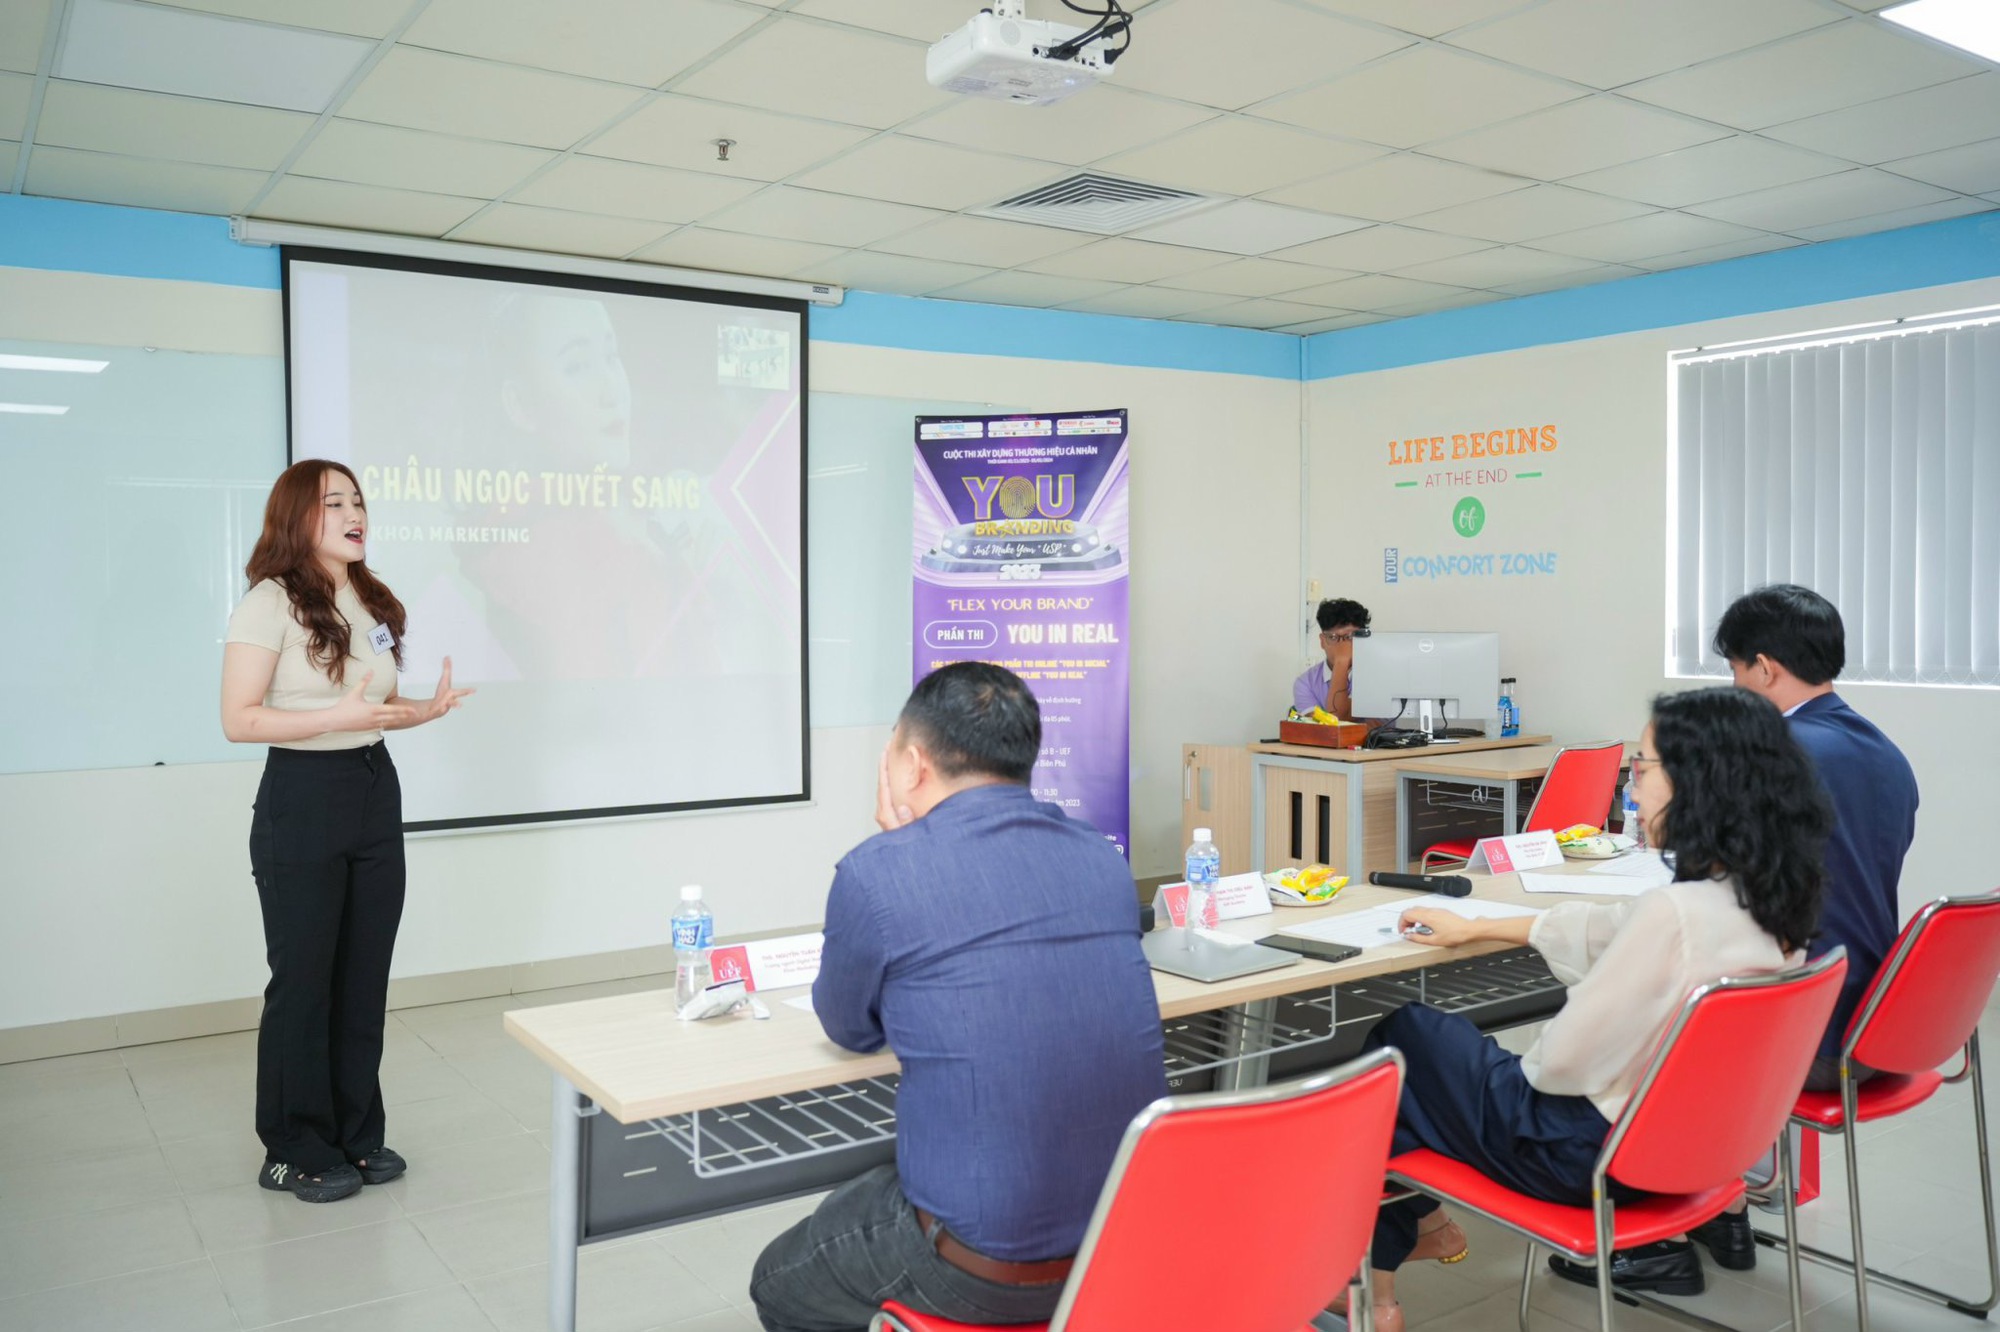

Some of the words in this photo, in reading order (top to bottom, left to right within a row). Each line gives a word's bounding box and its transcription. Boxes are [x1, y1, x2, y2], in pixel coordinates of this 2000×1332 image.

[943, 449, 963, 460] CUỘC
[964, 450, 976, 458] THI
[1046, 444, 1065, 457] HIỆU
[1076, 444, 1098, 455] NHÂN
[1388, 437, 1444, 465] LIFE
[1451, 425, 1557, 459] BEGINS
[362, 454, 442, 502] CHÂU
[454, 468, 530, 514] NGỌC
[540, 461, 622, 508] TUYẾT
[632, 475, 701, 510] SANG
[1425, 473, 1442, 488] AT
[1446, 470, 1473, 486] THE
[1477, 468, 1508, 484] END
[961, 474, 1075, 519] YOU
[975, 518, 1074, 537] BRANDING
[1459, 506, 1478, 531] of
[371, 526, 424, 542] KHOA
[430, 526, 531, 543] MARKETING
[972, 544, 990, 555] Just
[991, 543, 1015, 554] Make
[1016, 542, 1036, 557] Your
[1385, 548, 1398, 583] YOUR
[1403, 554, 1495, 579] COMFORT
[1500, 552, 1558, 575] ZONE
[992, 598, 1032, 611] YOUR
[375, 632, 389, 646] 041
[967, 629, 984, 641] THI
[1007, 624, 1044, 644] YOU
[1048, 624, 1066, 644] IN
[1072, 623, 1119, 644] REAL
[1065, 799, 1080, 807] 2023
